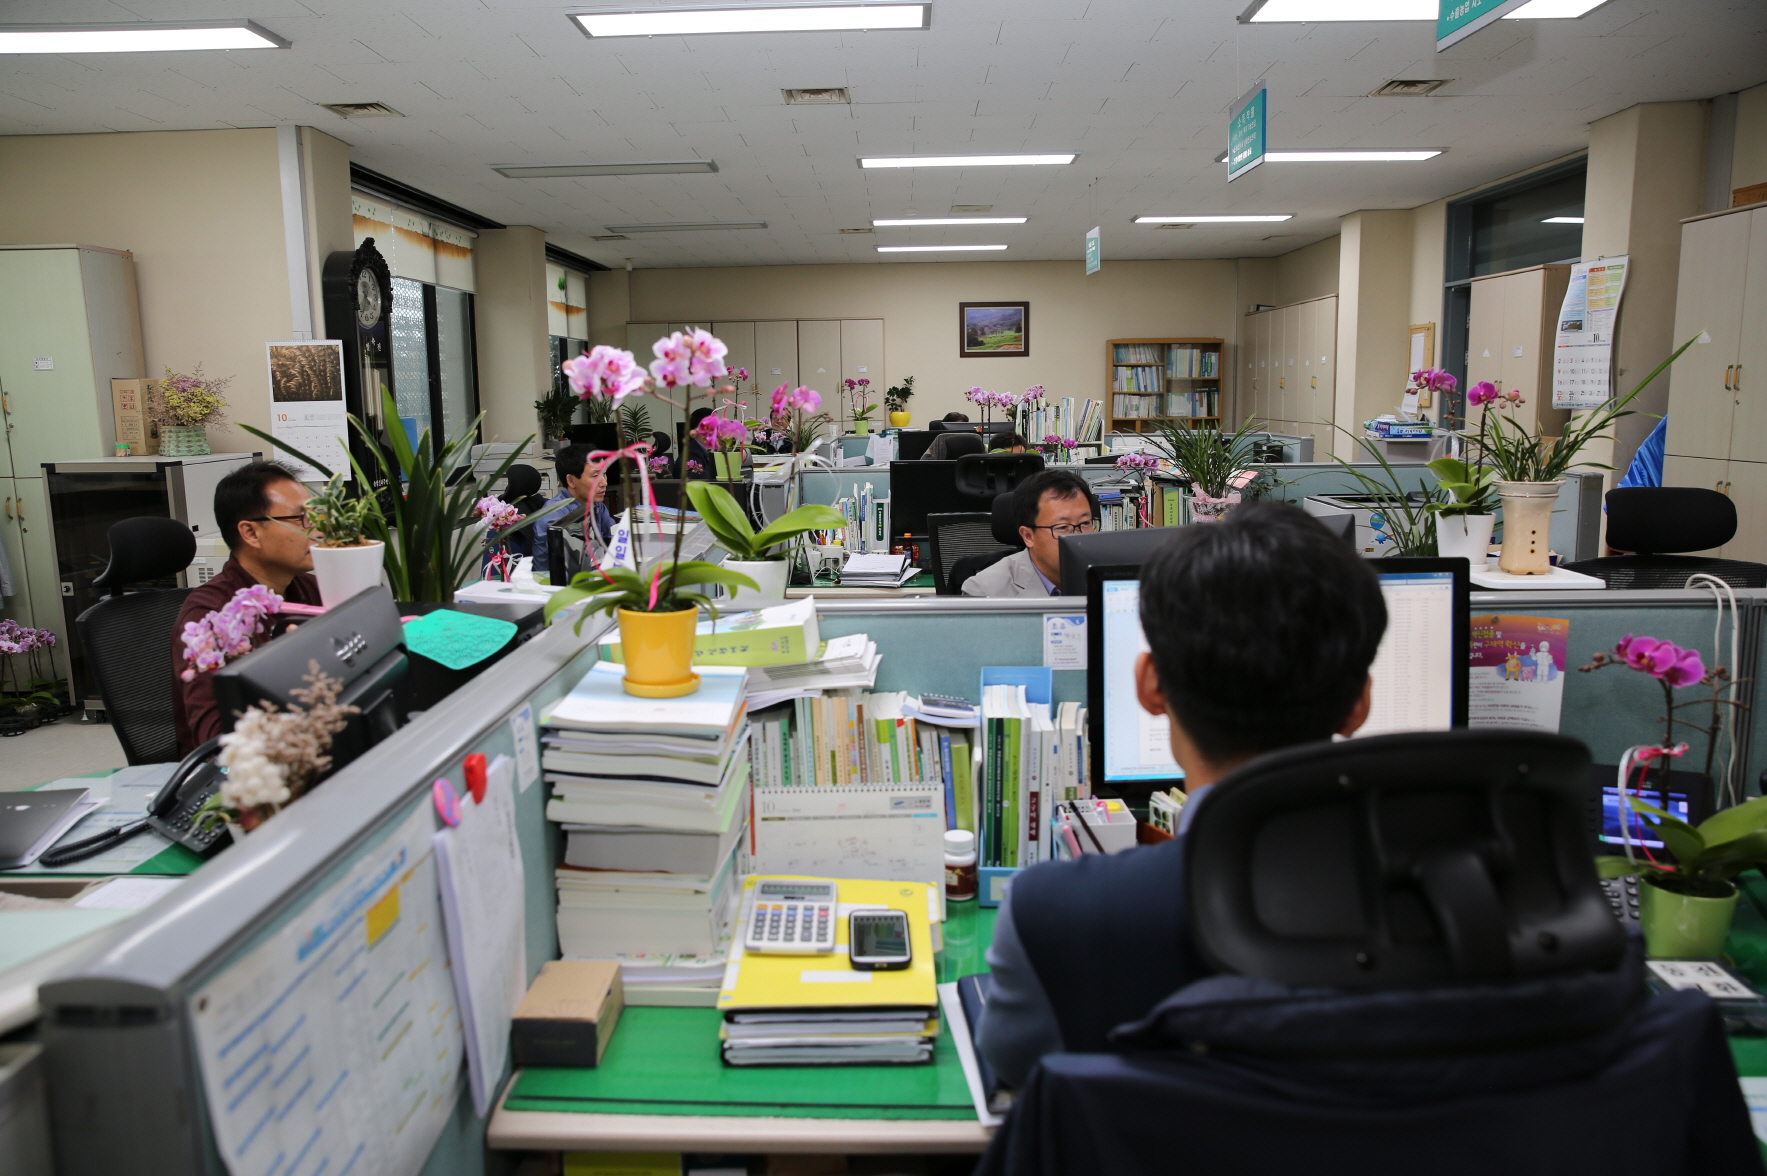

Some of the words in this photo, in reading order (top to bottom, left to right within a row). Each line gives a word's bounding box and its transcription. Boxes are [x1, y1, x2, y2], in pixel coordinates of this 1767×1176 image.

[1450, 0, 1470, 21] 수출농업
[1593, 333, 1600, 343] 10
[277, 414, 287, 422] 10
[762, 801, 776, 813] 10
